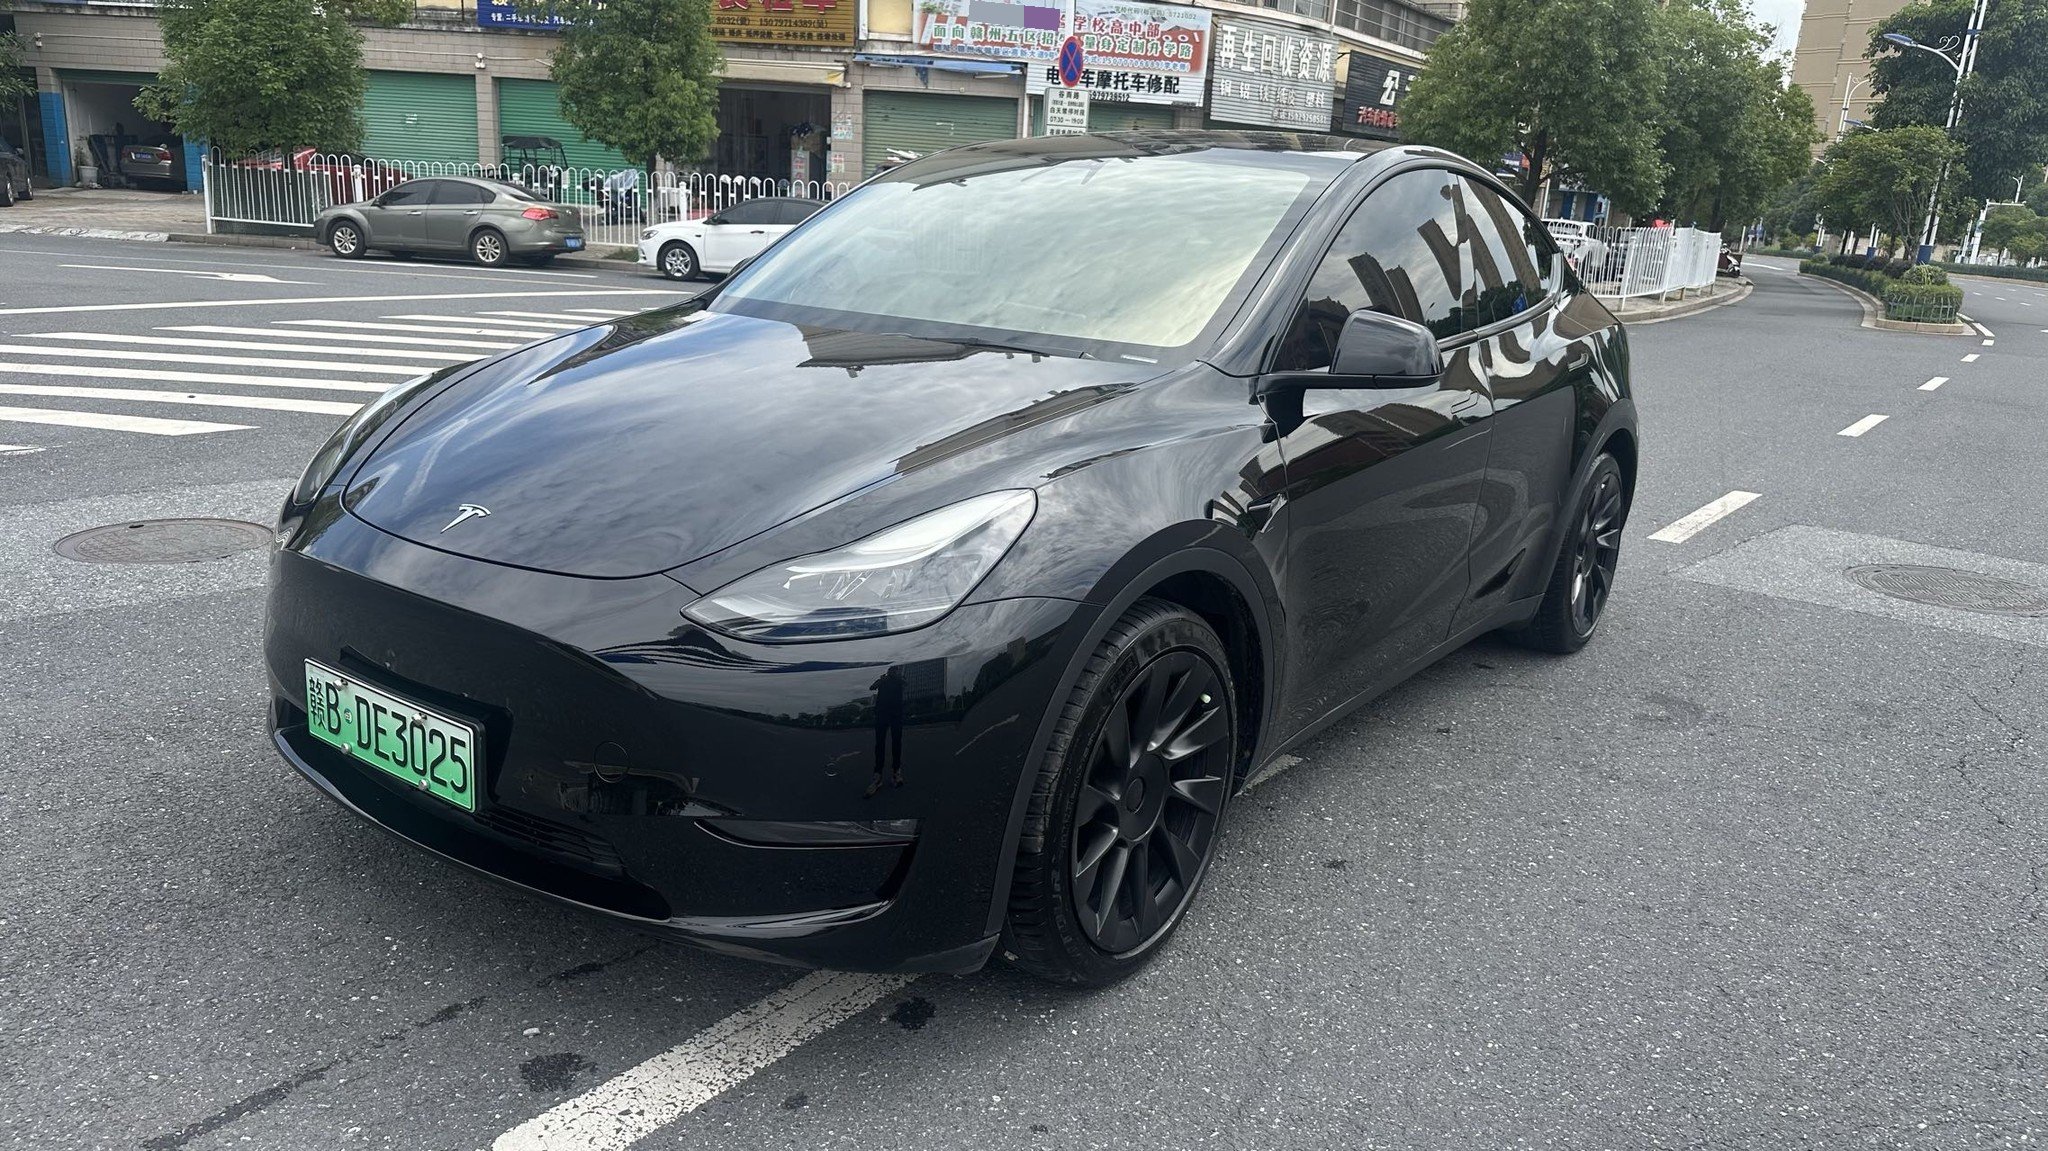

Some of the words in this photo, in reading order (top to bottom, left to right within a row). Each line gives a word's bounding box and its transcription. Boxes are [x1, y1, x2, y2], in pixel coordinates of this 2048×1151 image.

[1220, 24, 1333, 83] 再生回收资源
[1046, 65, 1180, 94] 电车摩托车修配
[1304, 91, 1325, 107] 塑料
